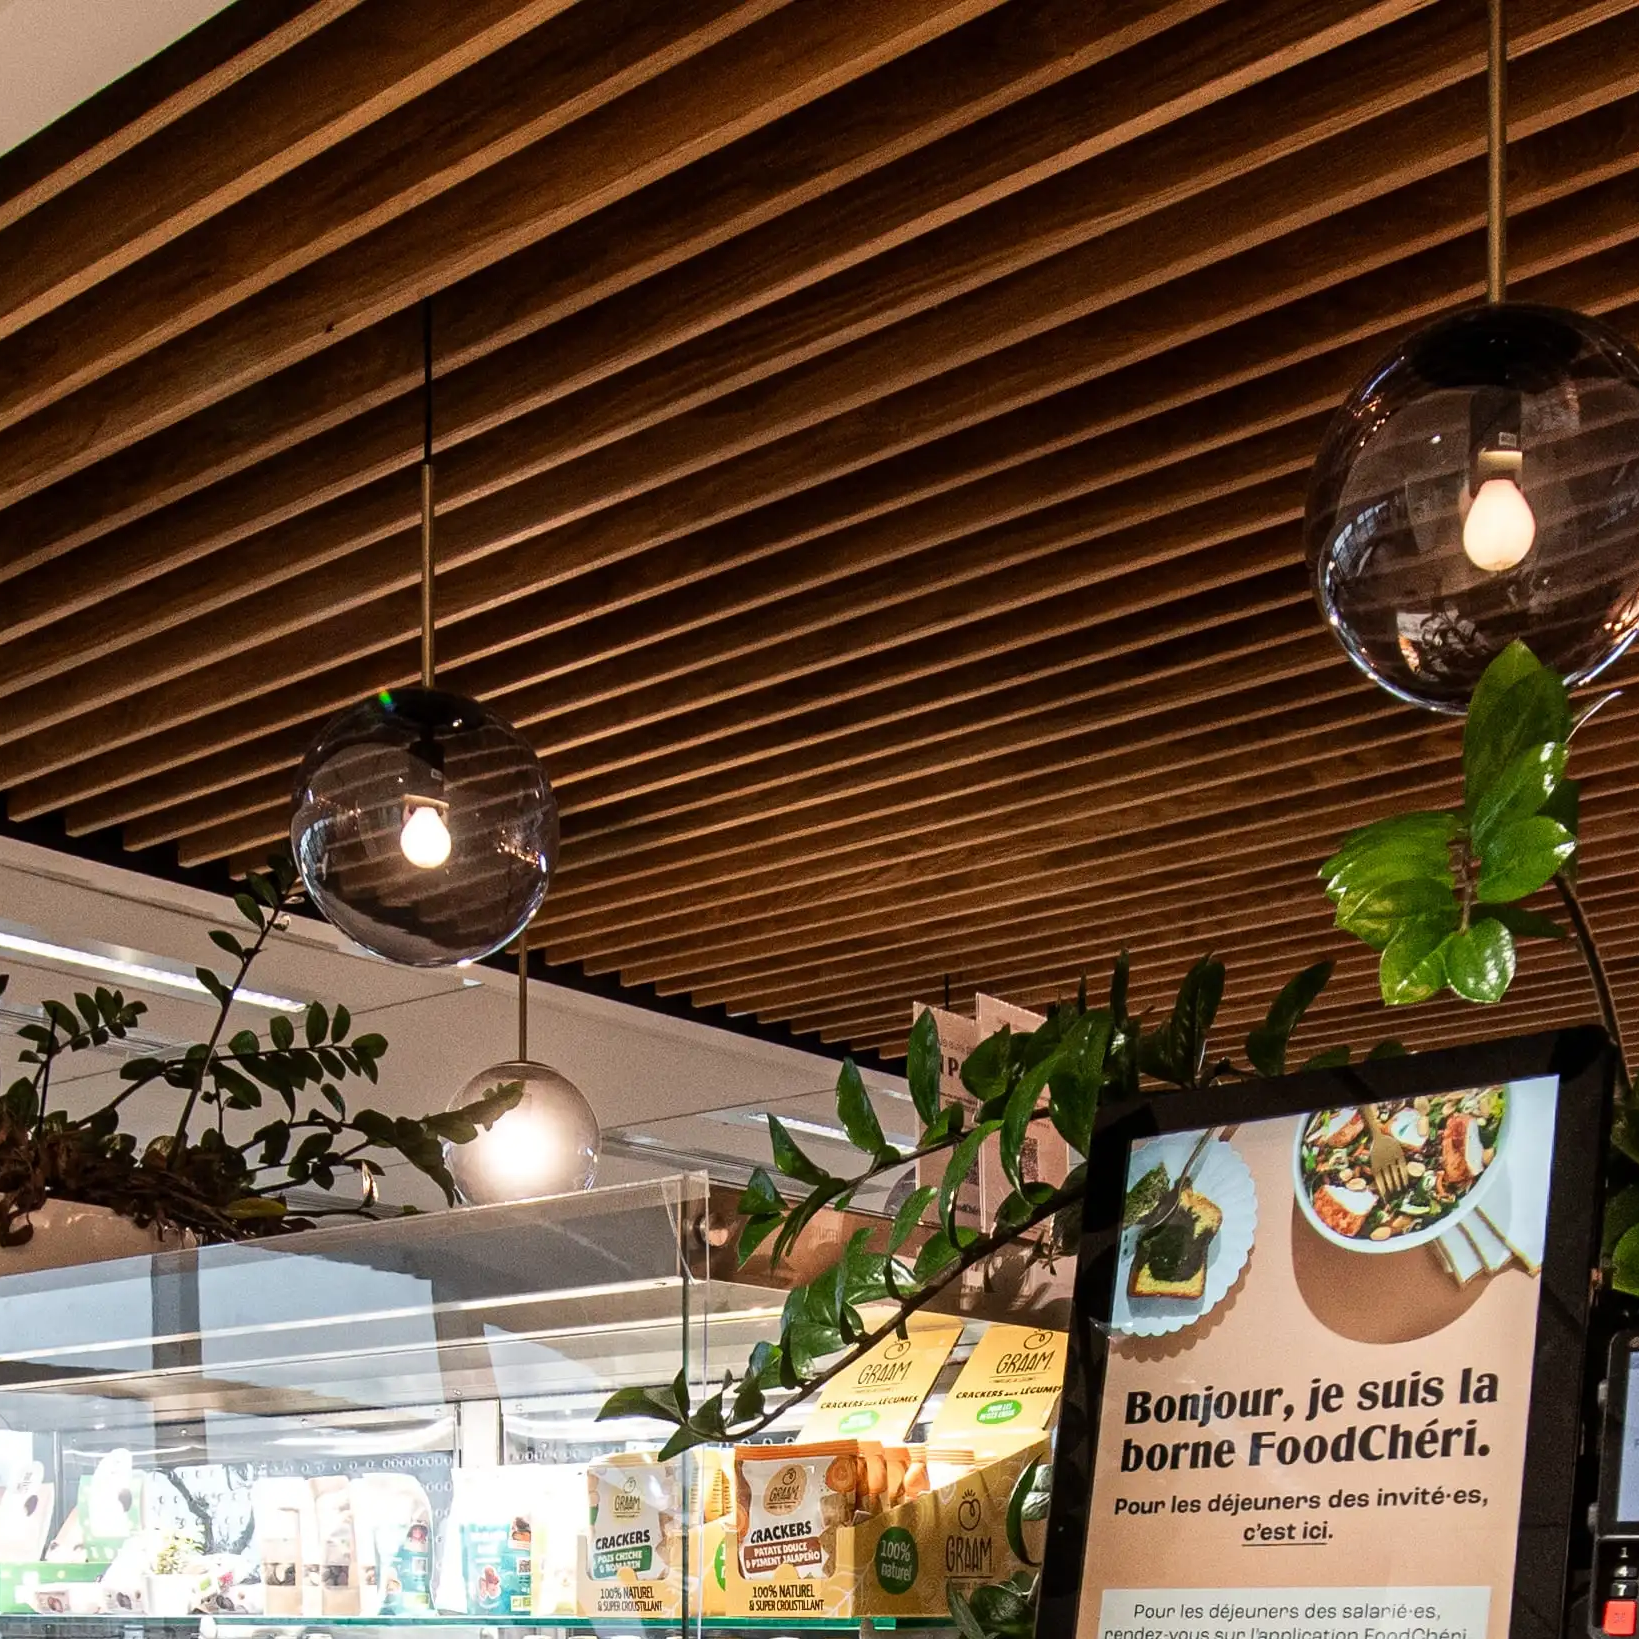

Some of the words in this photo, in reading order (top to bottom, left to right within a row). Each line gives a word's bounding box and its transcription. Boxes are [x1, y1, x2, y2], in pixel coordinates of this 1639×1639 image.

[956, 1390, 1003, 1399] CRACKERS
[1124, 1385, 1295, 1427] Bonjour,
[1306, 1377, 1345, 1422] je
[1357, 1371, 1445, 1411] suis
[1458, 1367, 1499, 1405] la
[820, 1400, 863, 1409] CRACKERS
[1121, 1438, 1235, 1473] borne
[1248, 1419, 1491, 1467] FoodChéri.
[1114, 1497, 1166, 1516] Pour
[1171, 1494, 1201, 1513] les
[1207, 1492, 1321, 1516] déjeuners
[1328, 1489, 1370, 1509] des
[750, 1520, 812, 1544] CRACKERS
[1243, 1522, 1297, 1542] c'est
[1302, 1521, 1334, 1540] ici.
[595, 1529, 651, 1551] CRACKERS
[753, 1544, 782, 1557] PATATE
[783, 1541, 808, 1554] DOUCE
[880, 1539, 911, 1562] 100%
[1619, 1546, 1628, 1559] 1
[751, 1555, 781, 1569] PIMENT
[880, 1562, 912, 1582] naturel
[1618, 1565, 1629, 1577] 4
[600, 1587, 622, 1599] 100%
[623, 1586, 655, 1599] NATUREL
[752, 1585, 778, 1598] 100%
[779, 1584, 815, 1598] NATUREL
[1617, 1584, 1627, 1597] 7
[602, 1601, 621, 1612] SUPER
[621, 1600, 663, 1612] CROUSTILLANT
[755, 1600, 776, 1611] SUPER
[776, 1599, 825, 1612] CROUSTILLANT
[1133, 1603, 1176, 1620] Pour
[1180, 1603, 1204, 1619] les
[1209, 1603, 1299, 1623] déjeuners
[1304, 1602, 1337, 1619] des
